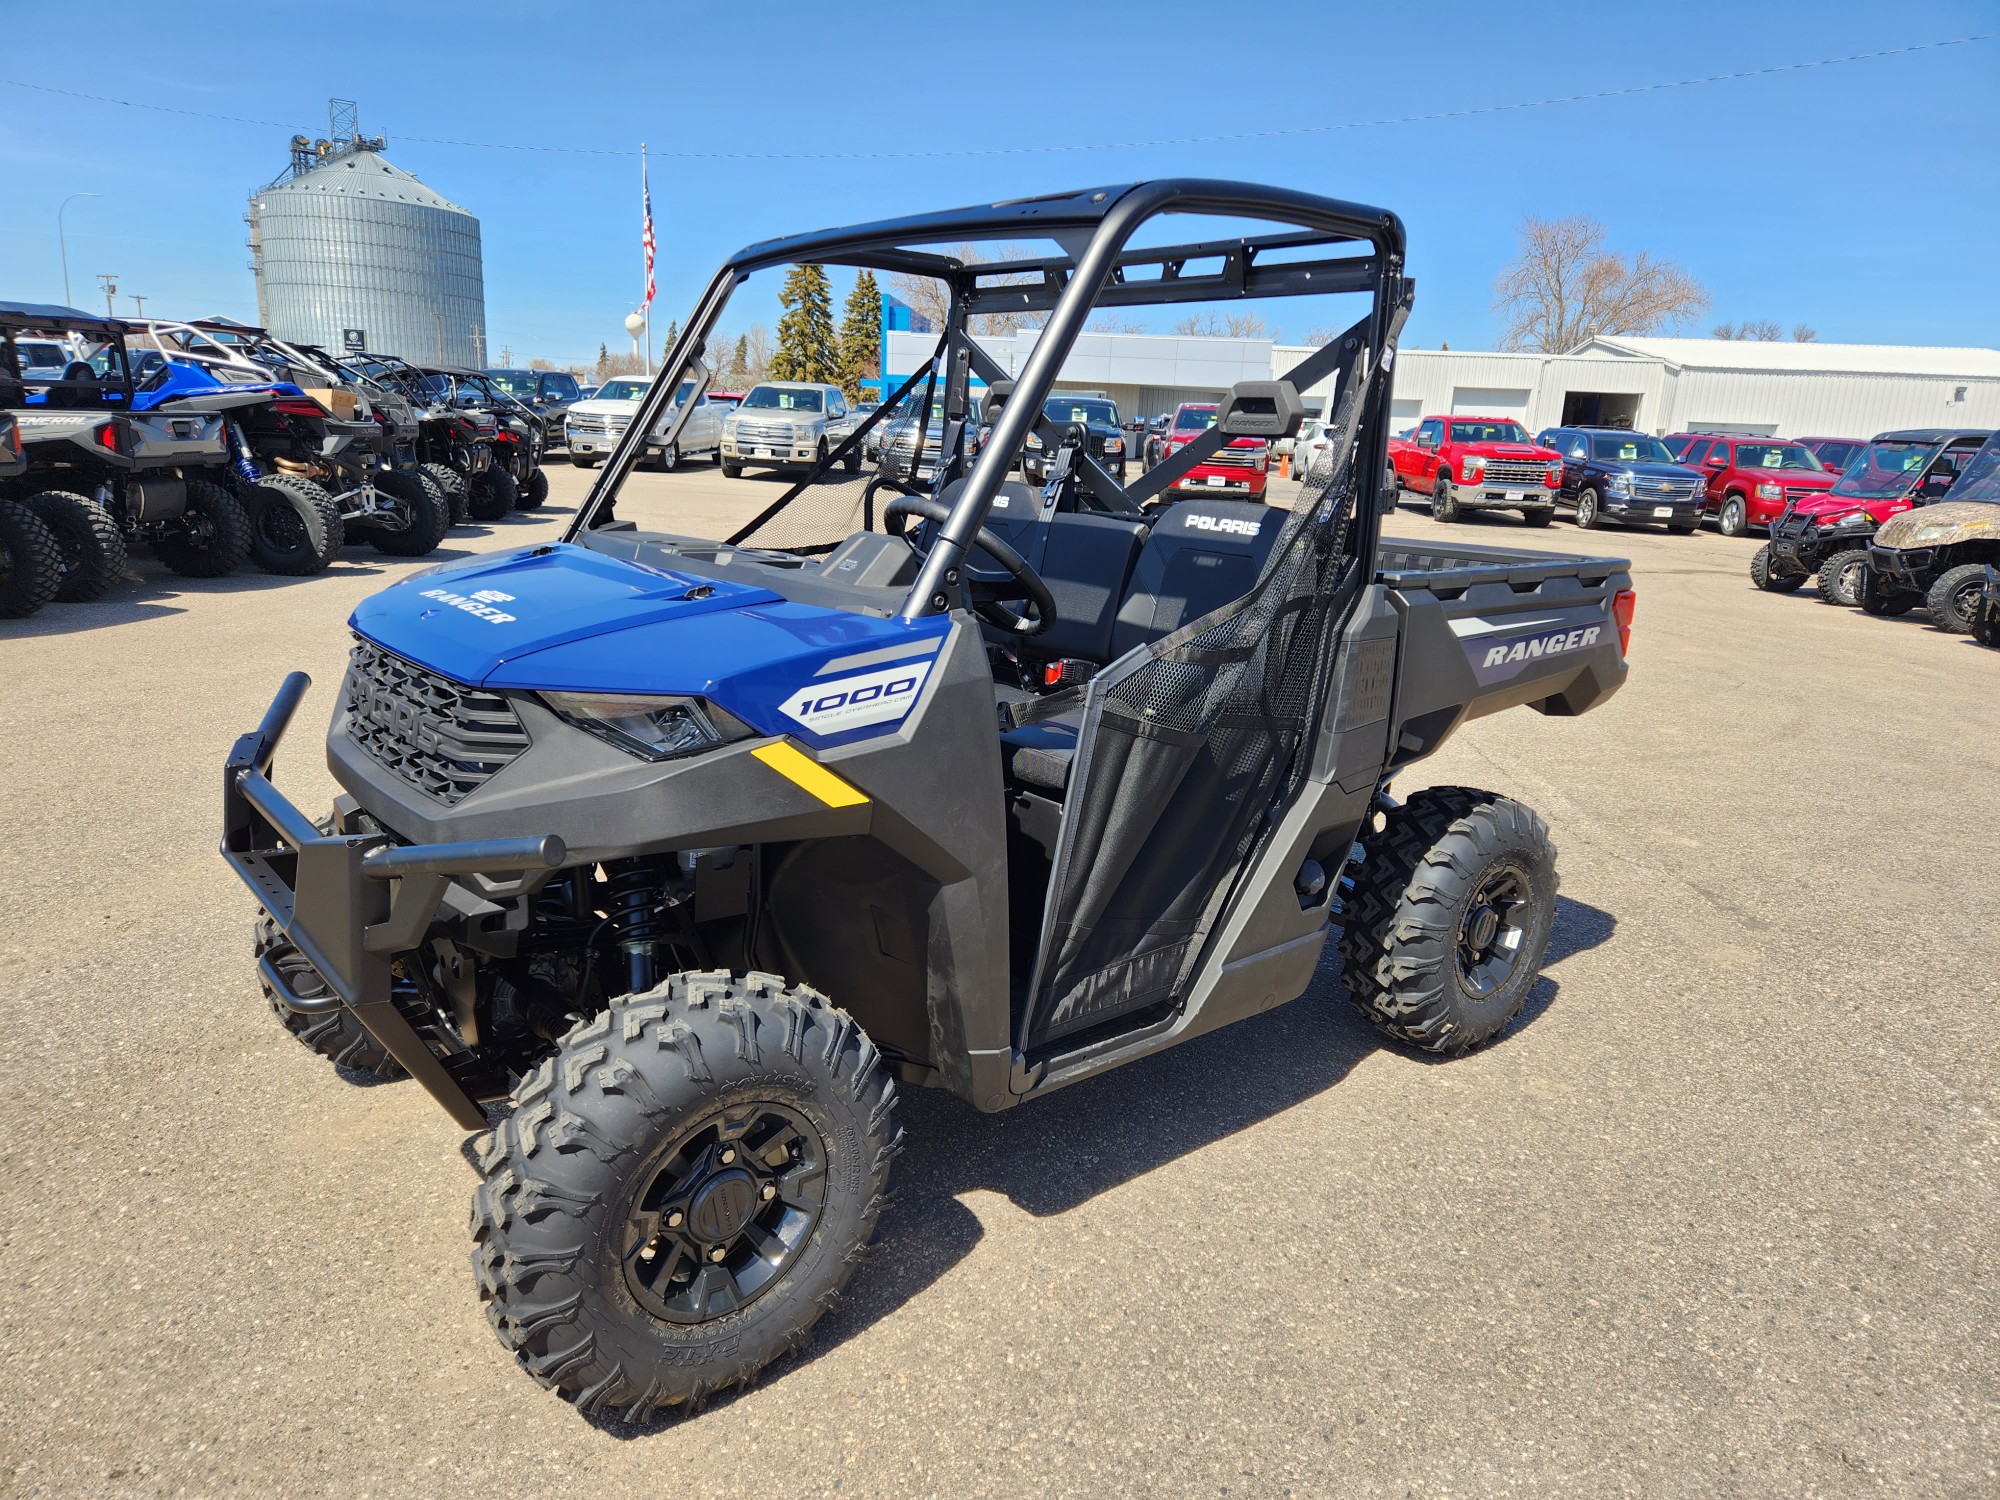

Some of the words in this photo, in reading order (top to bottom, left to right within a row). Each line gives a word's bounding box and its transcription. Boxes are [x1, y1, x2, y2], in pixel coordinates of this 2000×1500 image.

[17, 415, 87, 425] ENERAL
[1230, 420, 1277, 428] RANGER
[1185, 514, 1262, 536] POLARIS
[418, 589, 517, 624] RANGER
[1482, 626, 1601, 668] RANGER
[799, 677, 917, 716] 1000
[808, 711, 843, 723] SINGLE
[845, 698, 893, 714] OVERHEAD
[893, 694, 913, 703] CAM
[347, 672, 439, 756] POLARIS
